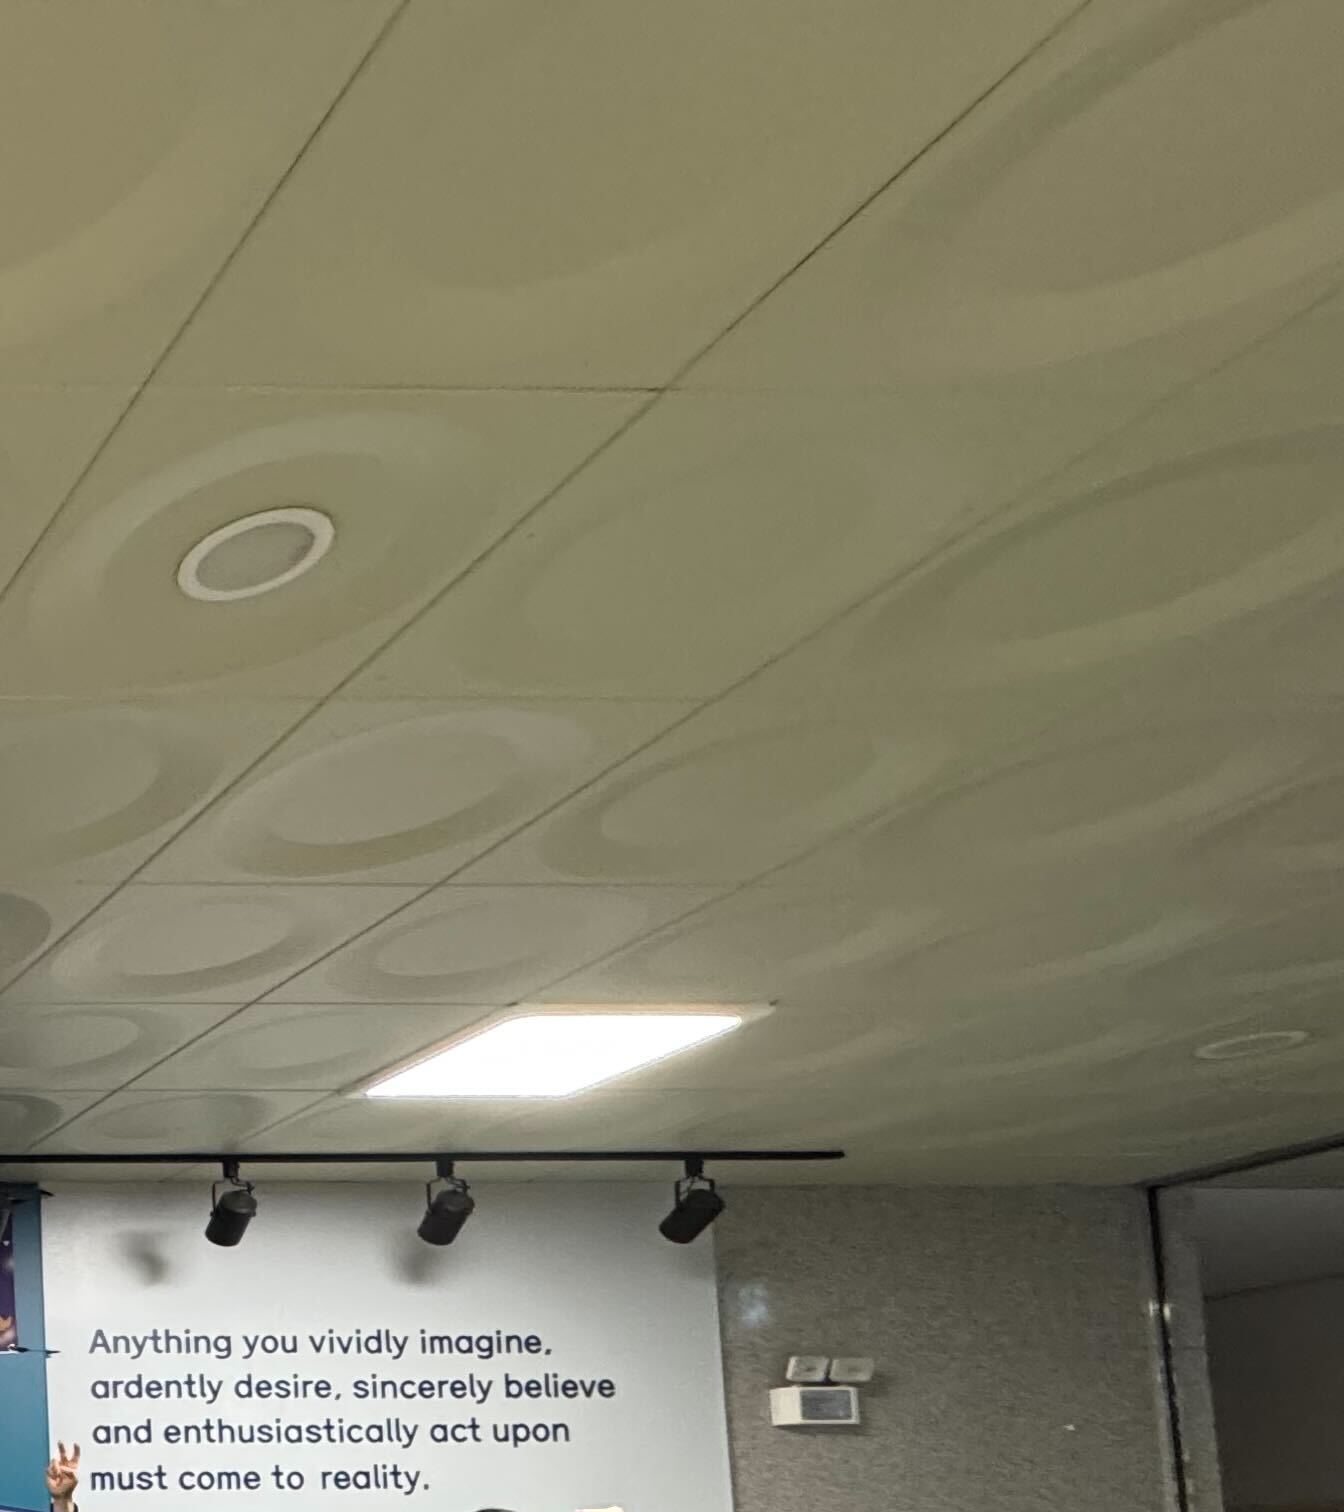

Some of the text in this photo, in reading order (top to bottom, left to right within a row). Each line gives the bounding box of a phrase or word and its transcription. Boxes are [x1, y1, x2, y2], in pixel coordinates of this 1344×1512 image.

[88, 1329, 553, 1359] Anything you vividly imagine,
[90, 1373, 616, 1404] ardently desire, sincerely believe
[92, 1417, 571, 1449] and enthusiastically act upon
[90, 1464, 431, 1496] must come to reality.
